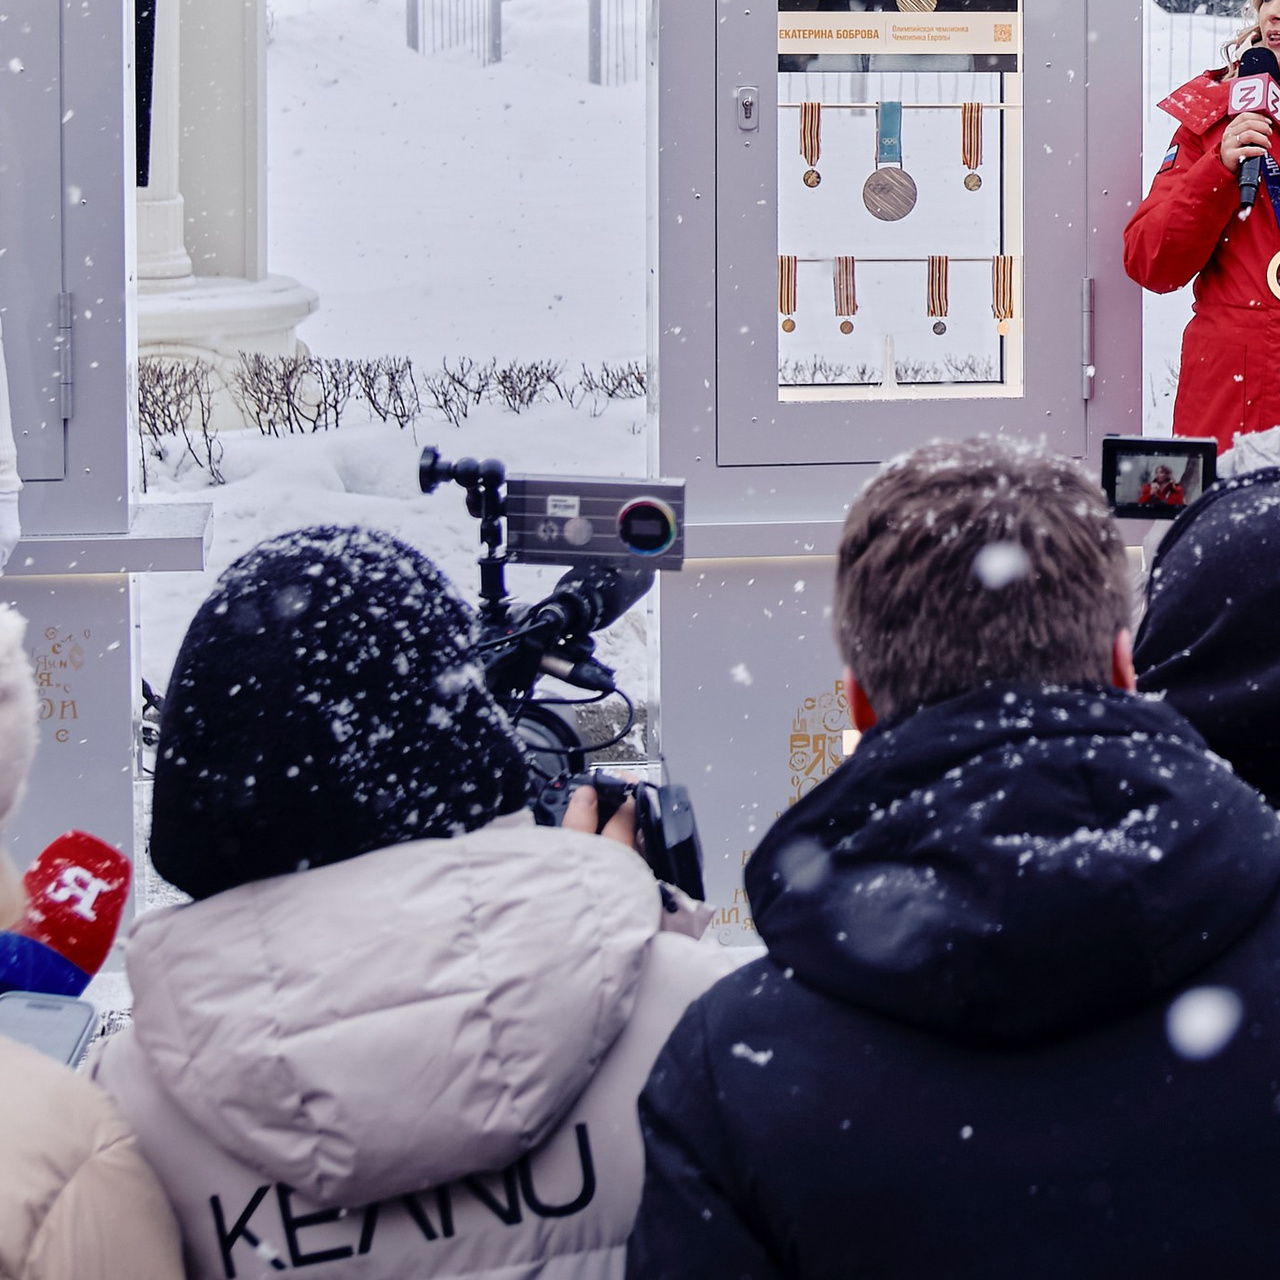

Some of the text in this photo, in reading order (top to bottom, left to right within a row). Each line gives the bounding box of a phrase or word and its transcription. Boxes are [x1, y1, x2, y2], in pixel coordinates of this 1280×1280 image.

[779, 28, 880, 40] ЕКАТЕРИНА БОБРОВА
[1264, 152, 1280, 177] 014
